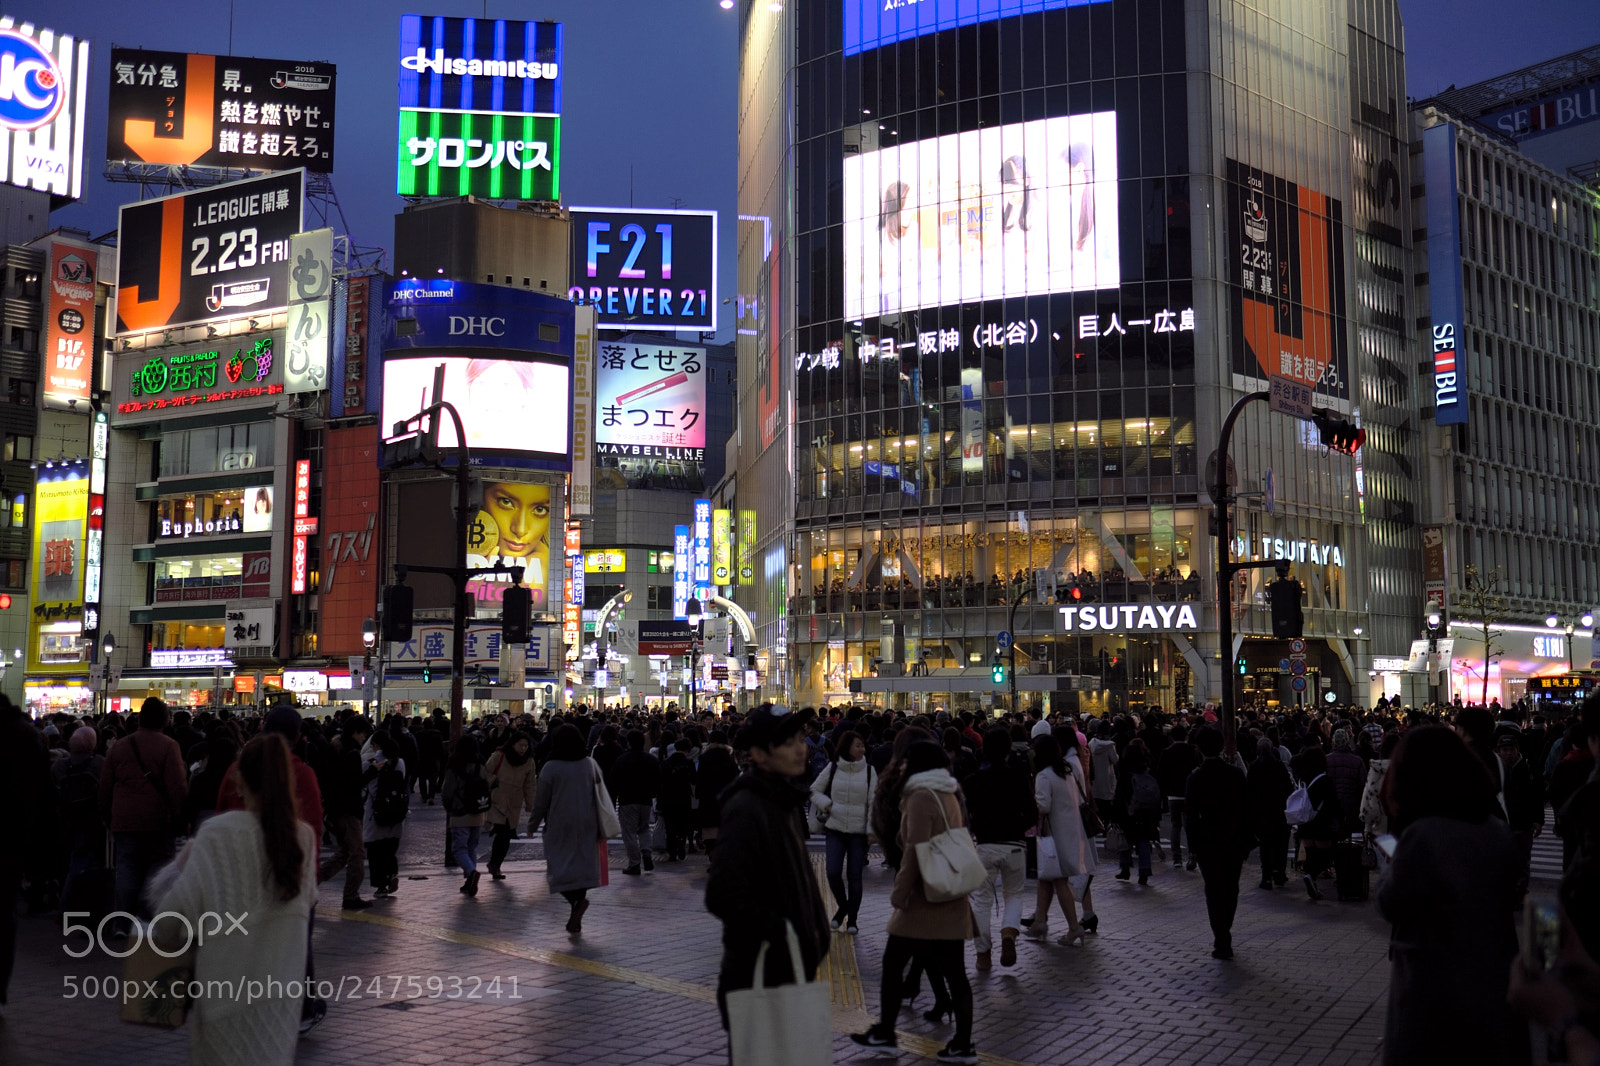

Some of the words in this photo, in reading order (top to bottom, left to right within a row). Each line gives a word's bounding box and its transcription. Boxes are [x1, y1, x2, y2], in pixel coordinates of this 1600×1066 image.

[114, 61, 179, 89] 気分急
[294, 65, 315, 74] 2018
[400, 47, 558, 80] Hisamitsu
[221, 69, 252, 93] 昇。
[166, 95, 175, 132] ジョウ
[219, 100, 331, 129] 熱を燃やせ。
[1495, 93, 1599, 138] SEIBU
[219, 130, 330, 159] 識を超えろ。
[406, 137, 551, 172] サロンパス
[25, 155, 66, 176] VISA
[190, 228, 258, 276] 2.23
[261, 240, 289, 264] FRI
[587, 221, 674, 281] F21
[1242, 243, 1268, 272] 2.23
[393, 289, 414, 300] DHC
[415, 288, 454, 299] Channel
[567, 286, 674, 317] OREVER
[680, 289, 706, 317] 21
[291, 248, 331, 388] もんじゃ
[448, 316, 506, 337] DHC
[57, 337, 83, 353] B1F
[601, 345, 702, 374] 落とせる
[56, 354, 84, 370] B2F
[169, 361, 217, 392] 西村
[574, 329, 591, 398] Taisei
[1280, 350, 1344, 389] 識を超えろ。
[1433, 323, 1457, 406] SEIBU
[1273, 380, 1309, 405] 渋谷駅前
[601, 404, 700, 431] まつエク
[573, 403, 586, 462] neon
[597, 443, 704, 460] MAYBELLINE
[161, 516, 240, 538] Euphoria
[695, 503, 709, 581] 洋服の青山
[870, 531, 990, 554] STARBUCKS
[1262, 537, 1343, 567] TSUTAYA
[45, 538, 74, 576] 薬
[245, 556, 270, 578] JTB
[675, 534, 688, 617] 洋服の青山
[716, 569, 727, 577] 4F
[1058, 604, 1197, 630] TSUTAYA
[1533, 636, 1563, 657] SEIBU
